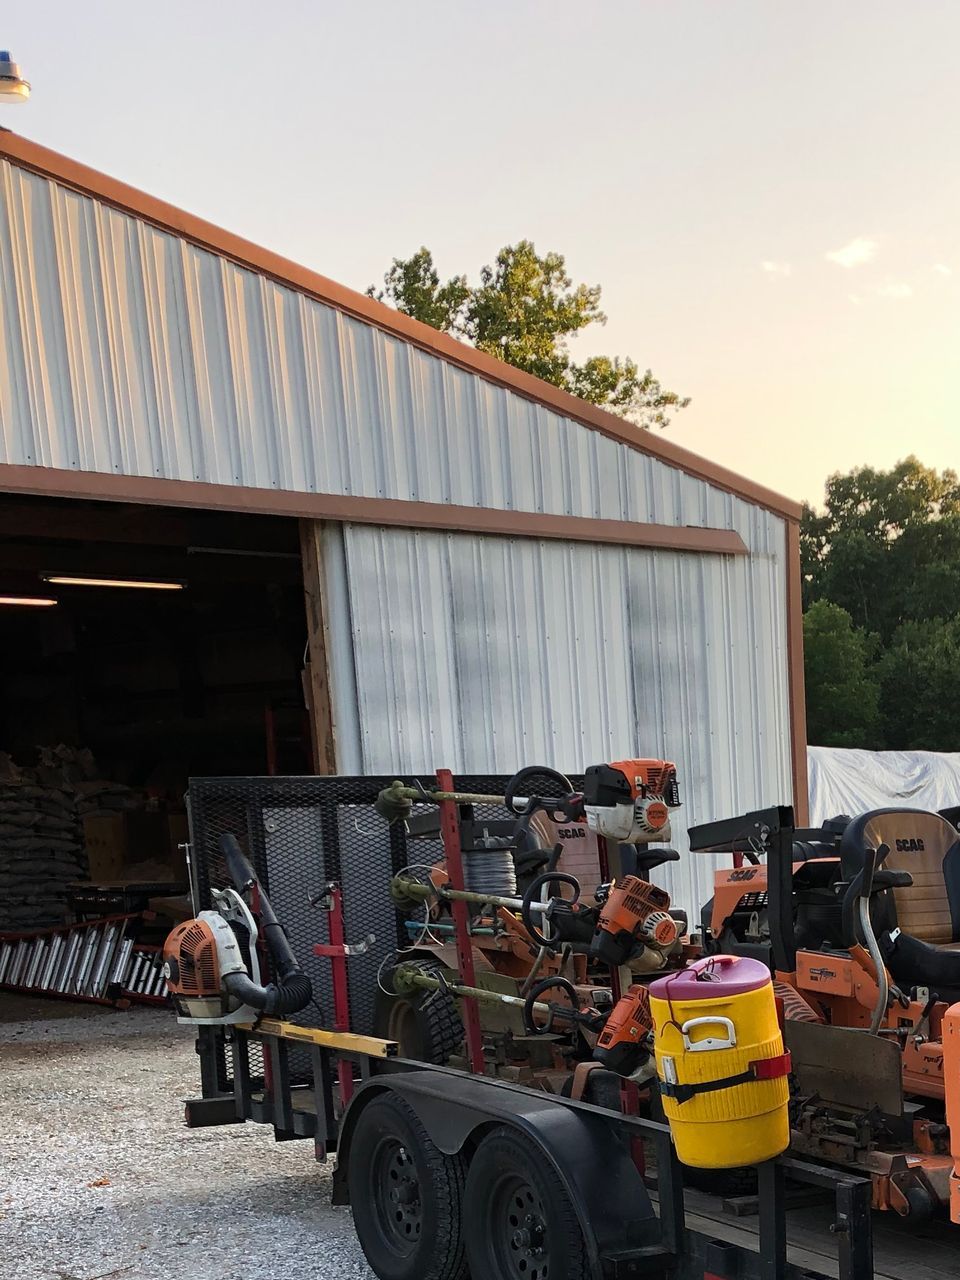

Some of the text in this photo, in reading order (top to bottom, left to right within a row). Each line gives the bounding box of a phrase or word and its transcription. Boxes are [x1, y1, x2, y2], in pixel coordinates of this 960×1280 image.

[558, 828, 586, 838] SCAG
[896, 838, 925, 852] SCAG
[729, 869, 755, 882] SCAG
